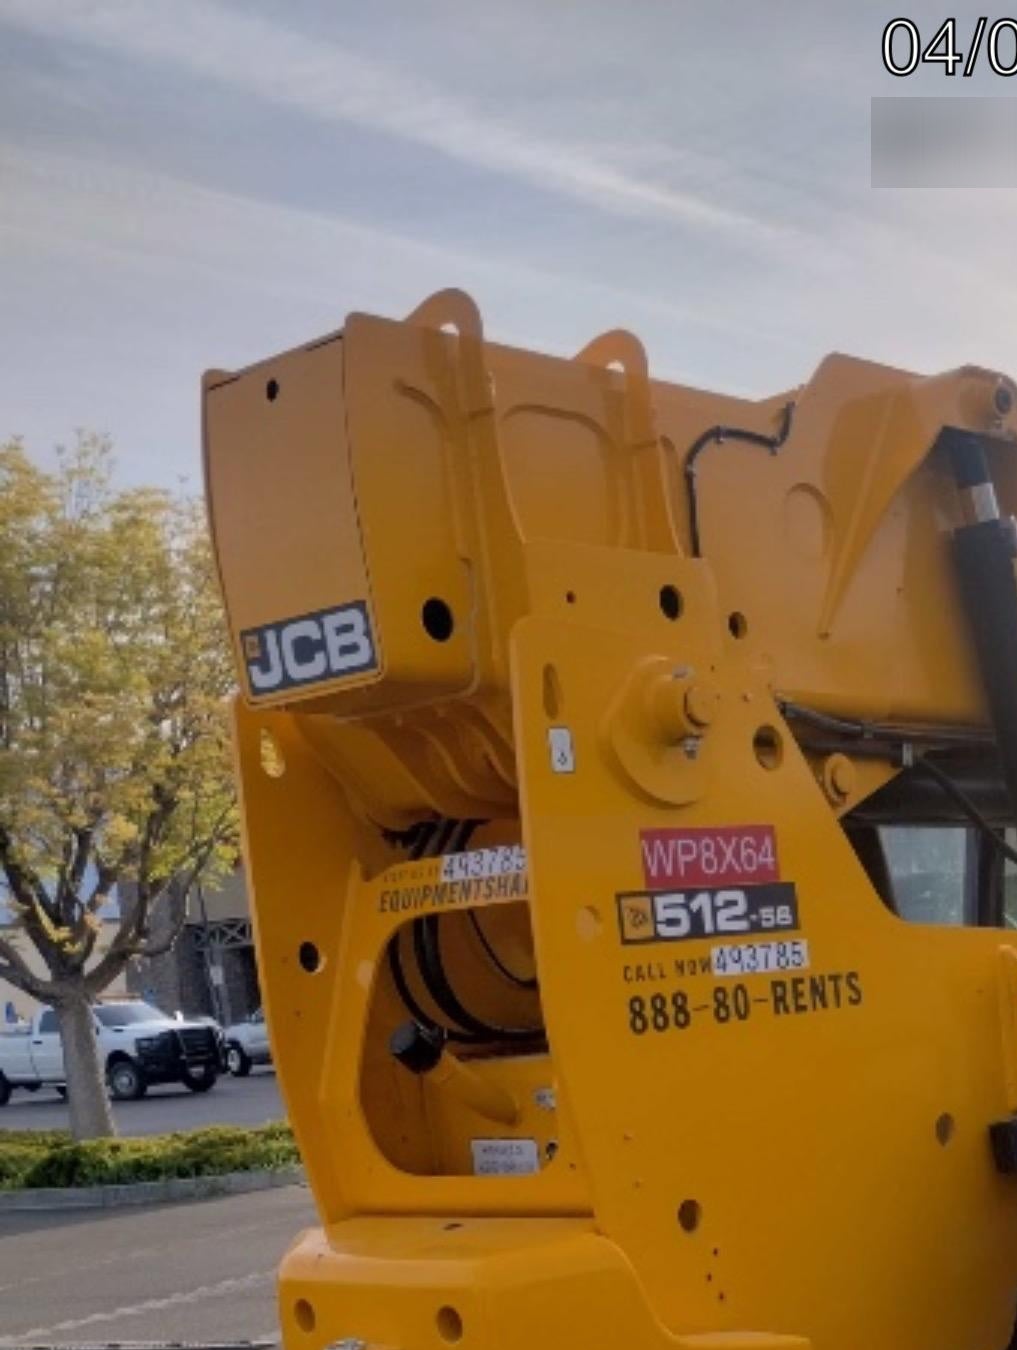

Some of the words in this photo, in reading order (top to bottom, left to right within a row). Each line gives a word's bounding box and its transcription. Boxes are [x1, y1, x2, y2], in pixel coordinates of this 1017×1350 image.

[248, 608, 373, 688] JCB
[642, 834, 776, 878] WP8X64
[379, 872, 529, 913] EQUIPMENTSHA
[623, 962, 667, 985] CALL
[674, 956, 712, 977] NOW
[713, 941, 805, 973] 493785
[628, 971, 863, 1036] 888-80-RENTS
